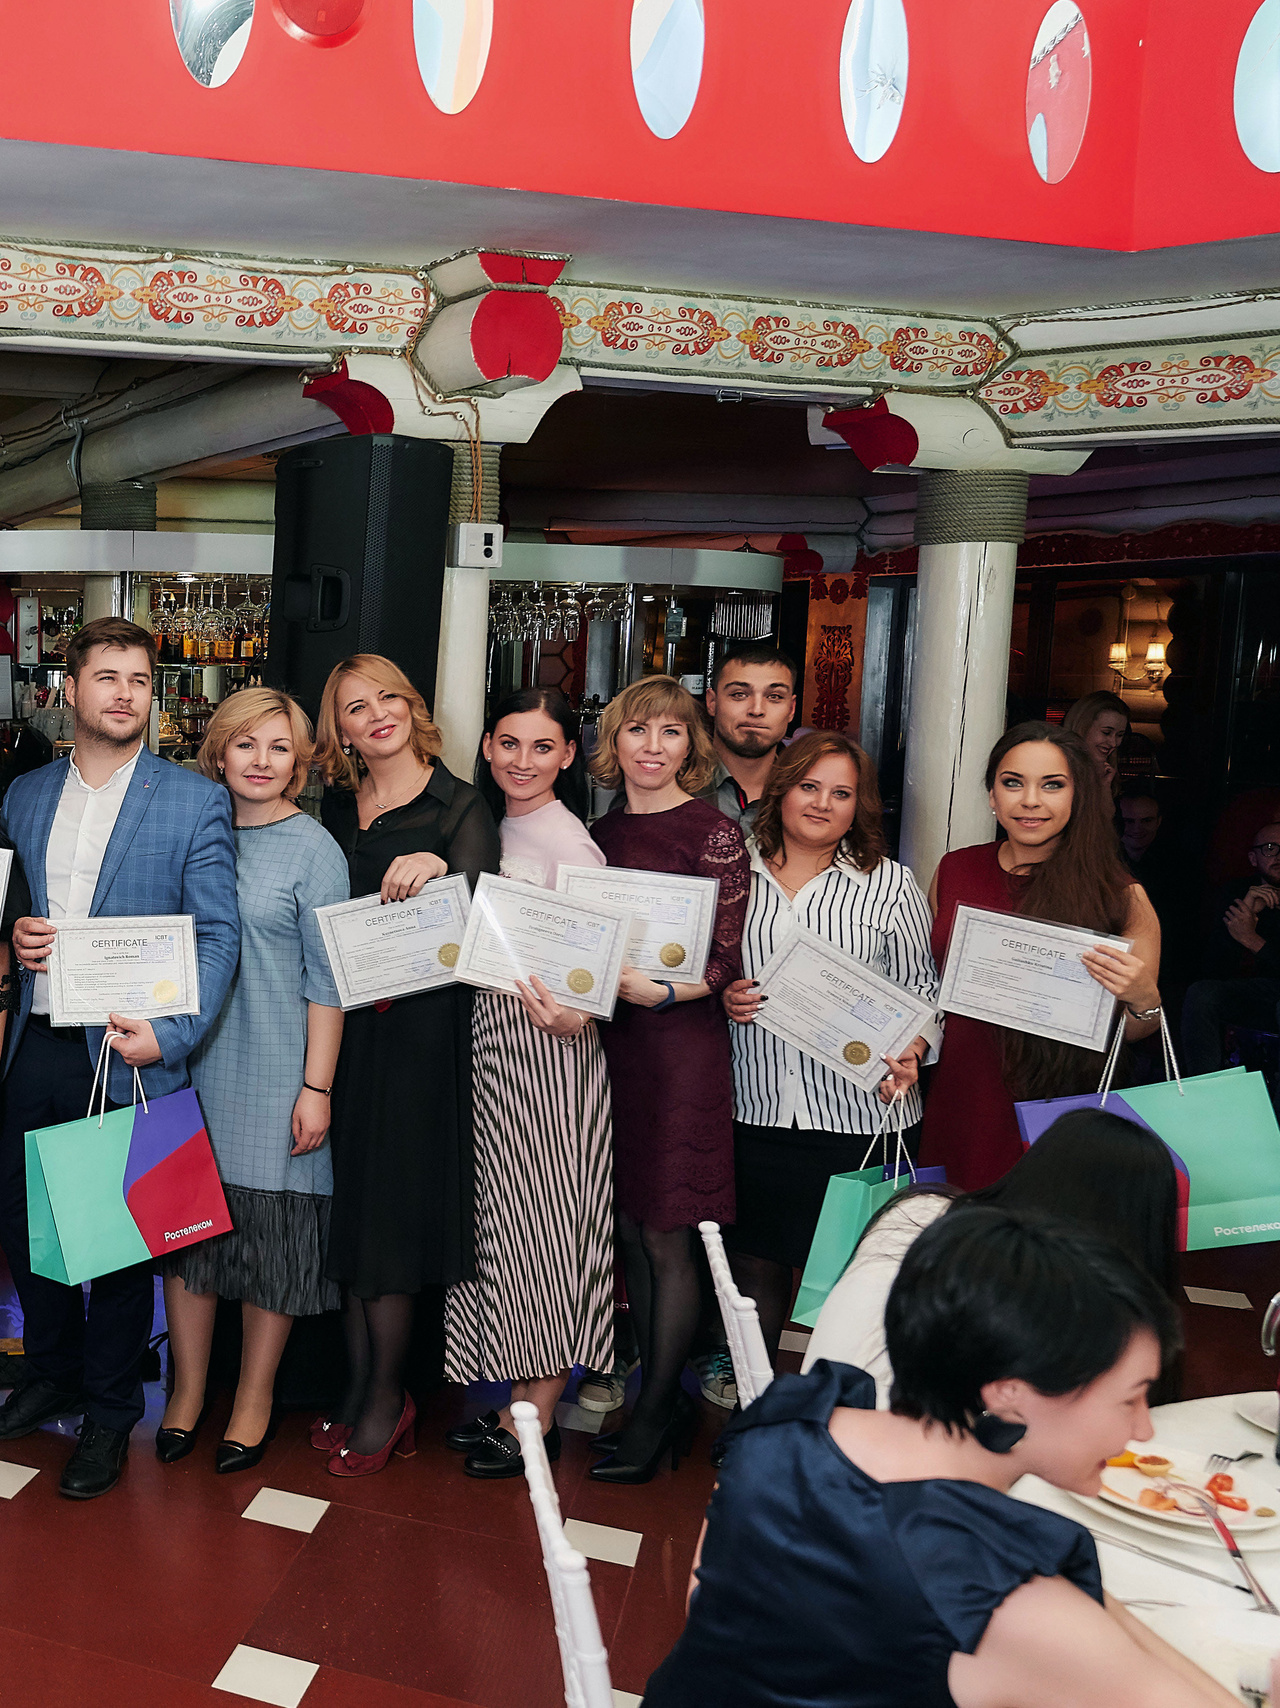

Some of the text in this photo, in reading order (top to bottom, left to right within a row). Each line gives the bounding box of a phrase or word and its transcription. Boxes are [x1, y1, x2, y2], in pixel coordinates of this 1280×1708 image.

[601, 891, 662, 905] CERTIFICATE
[365, 907, 423, 927] CERTIFICATE
[519, 906, 578, 929] CERTIFICATE
[91, 938, 148, 948] CERTIFICATE
[1001, 938, 1066, 961] CERTIFICATE
[820, 969, 876, 1007] CERTIFICATE
[884, 1003, 898, 1013] ICBT
[164, 1219, 213, 1242] Ростелеком
[1213, 1222, 1280, 1237] Ростелеко
